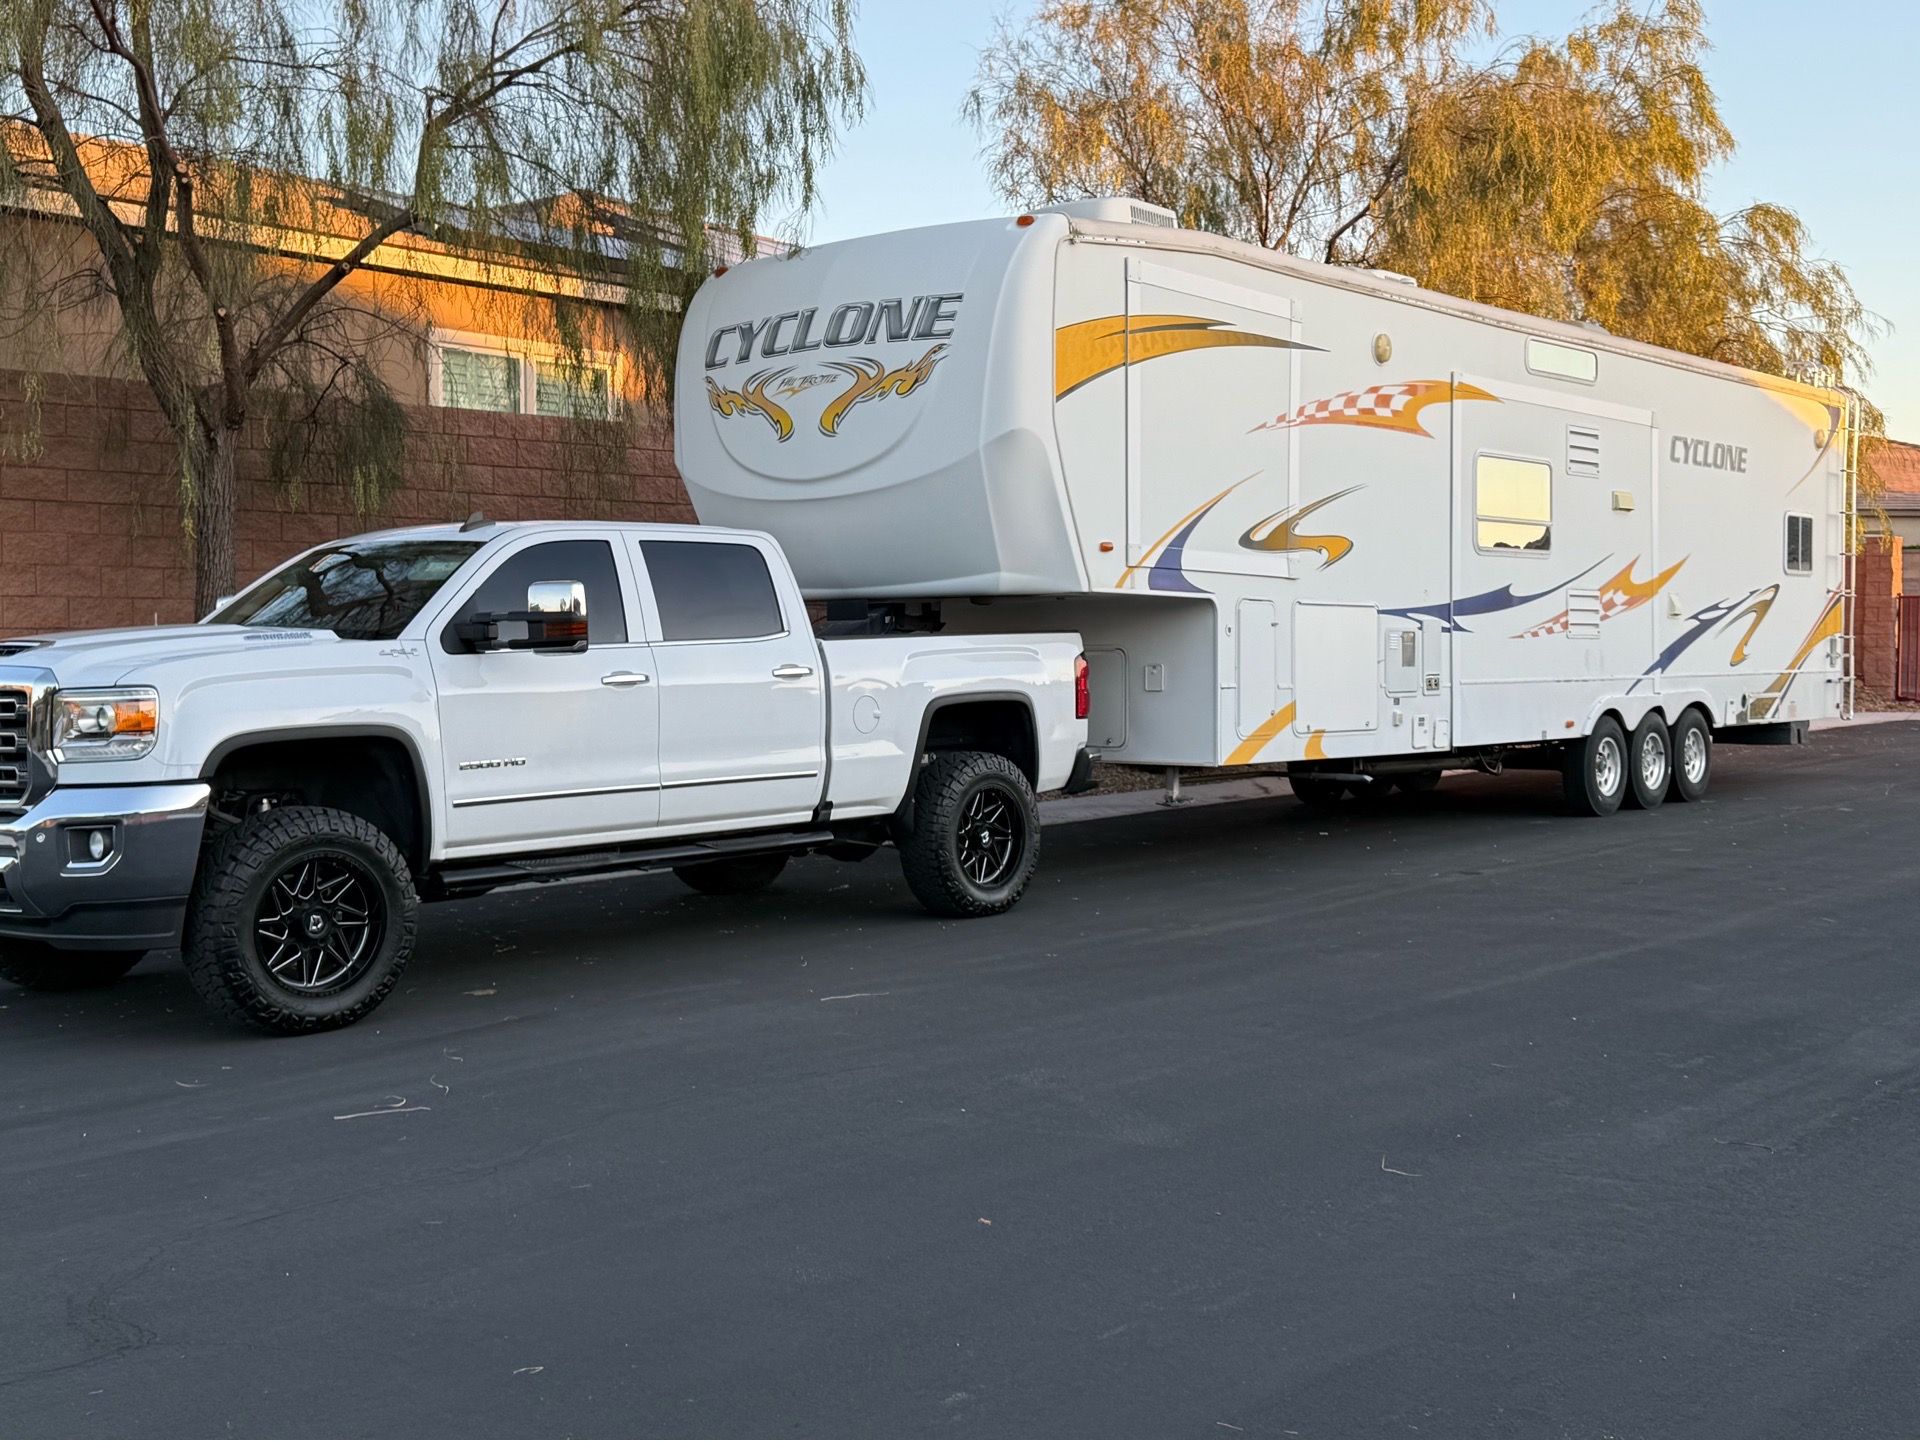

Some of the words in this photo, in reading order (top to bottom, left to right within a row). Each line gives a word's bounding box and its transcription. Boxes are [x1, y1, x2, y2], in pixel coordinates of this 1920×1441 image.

[705, 292, 964, 370] CYCLONE
[1669, 435, 1748, 474] CYCLONE
[503, 757, 526, 767] HD
